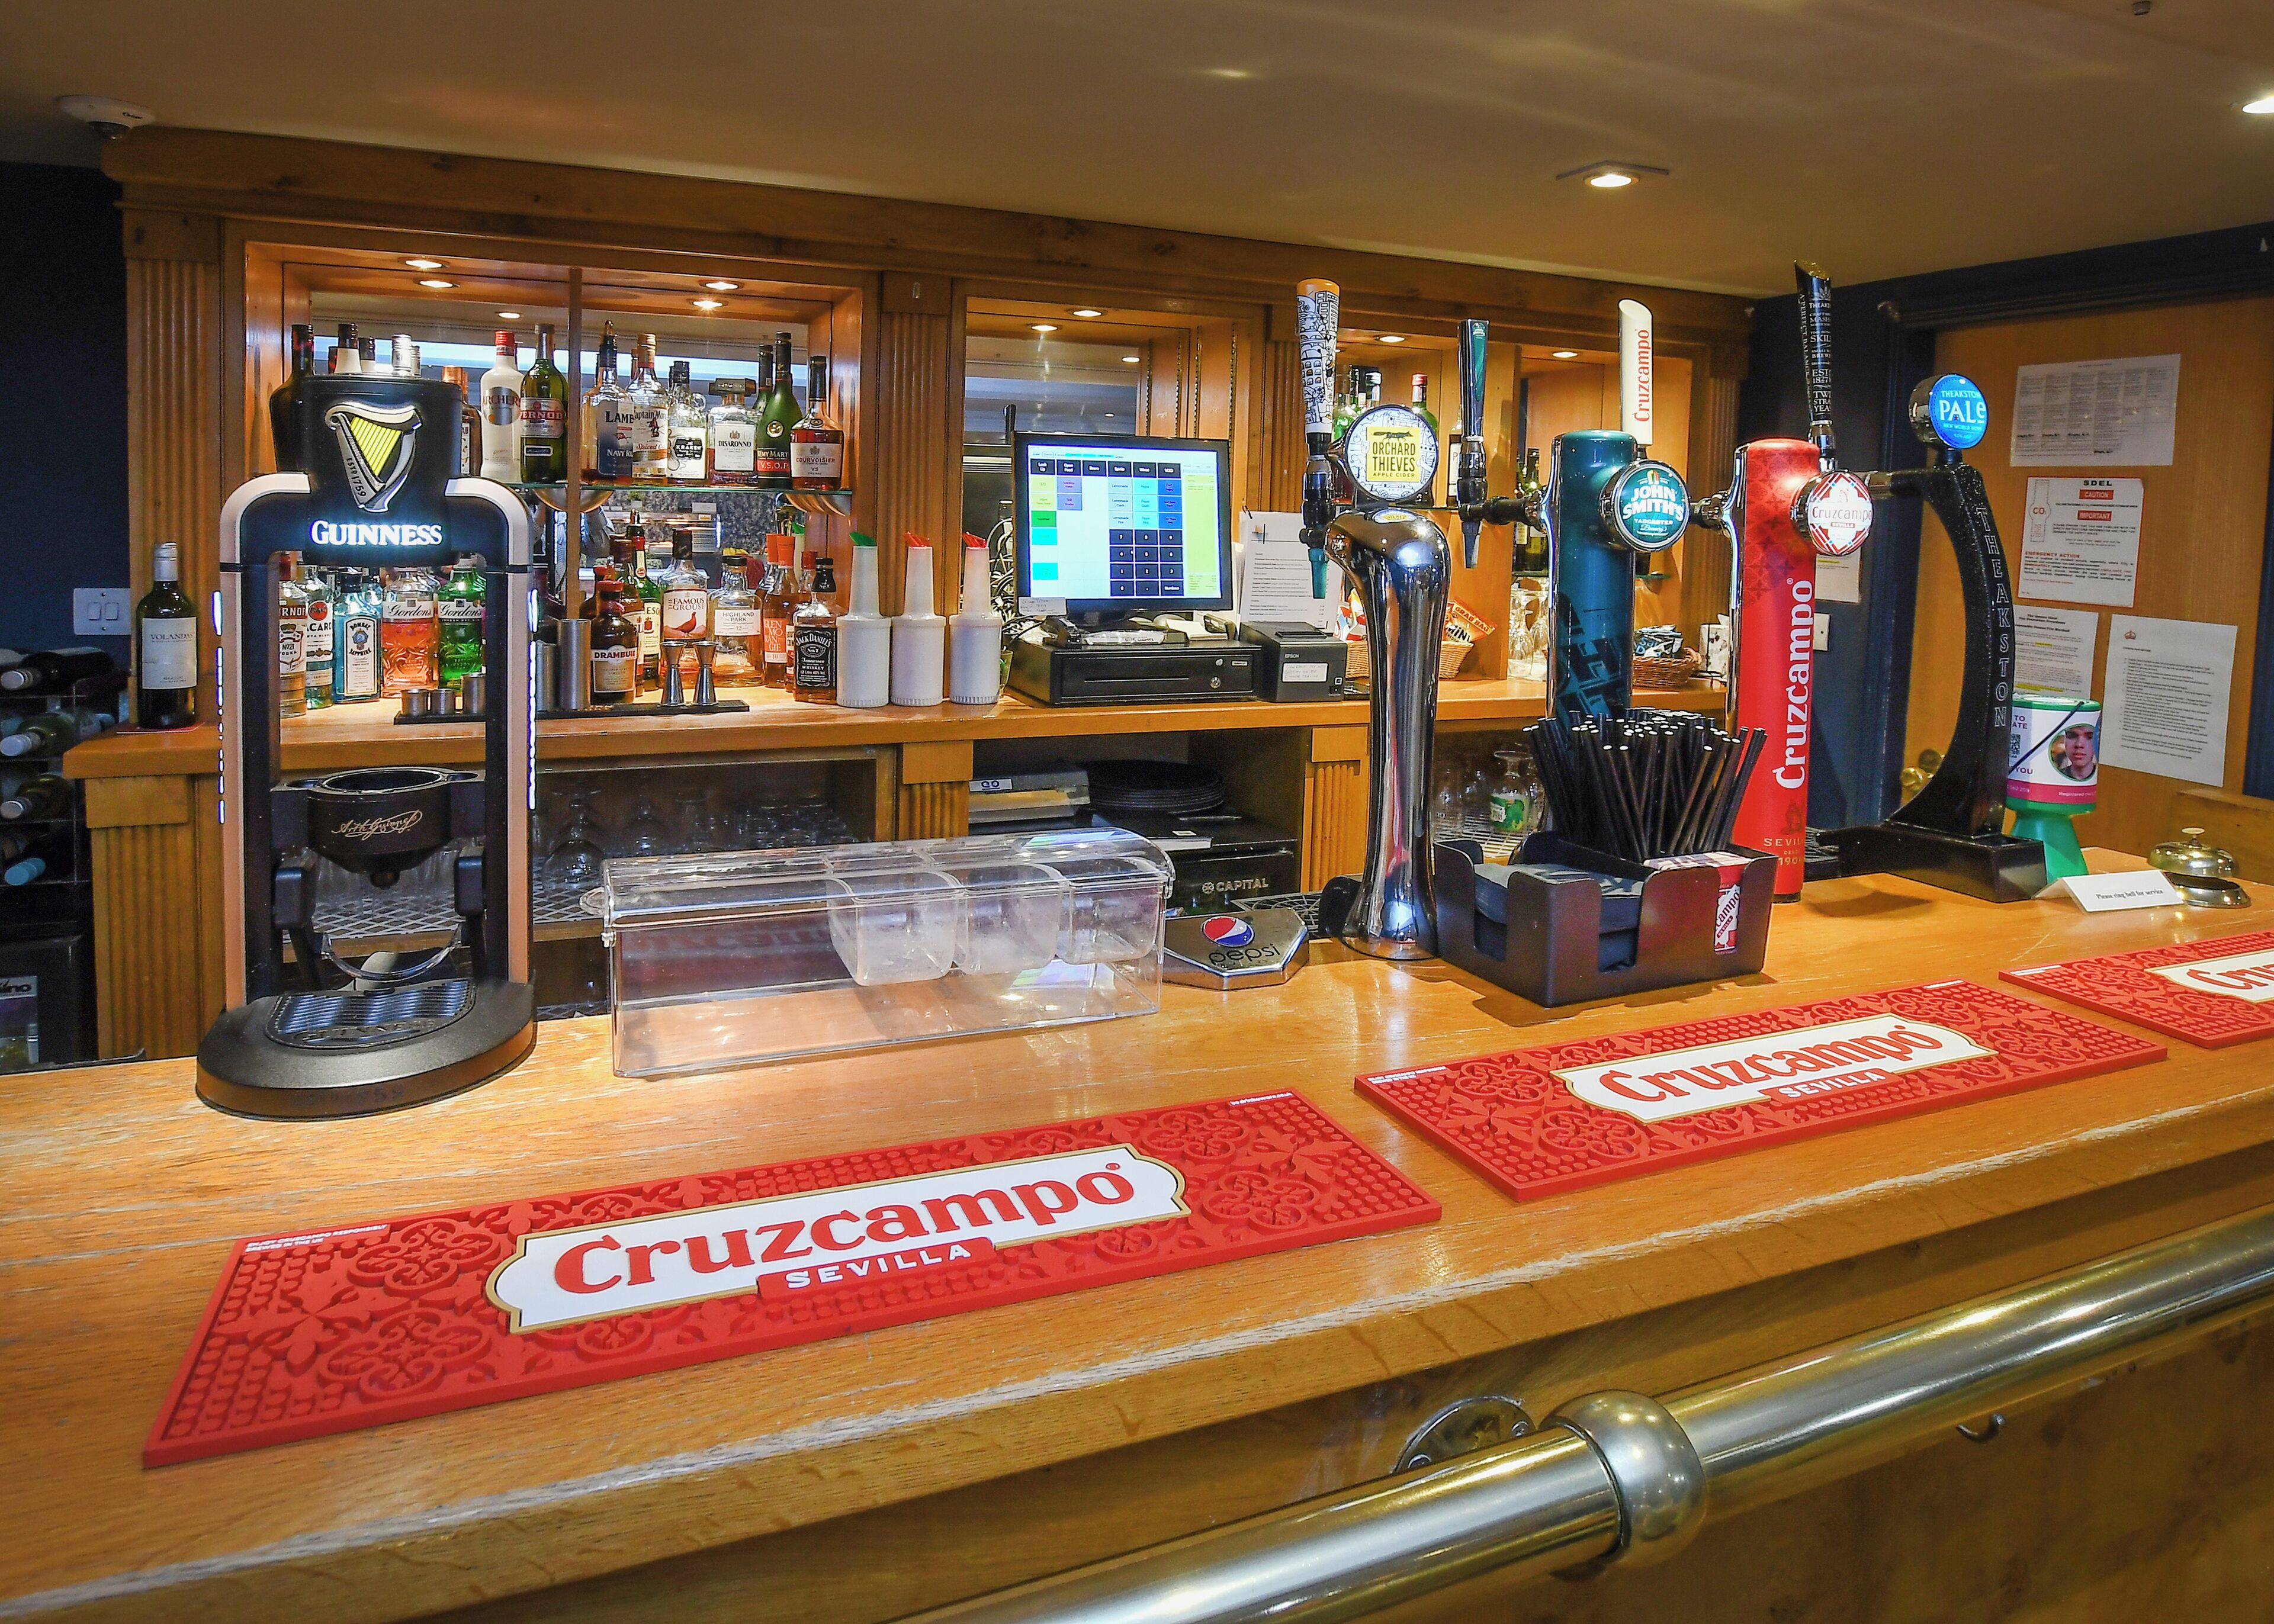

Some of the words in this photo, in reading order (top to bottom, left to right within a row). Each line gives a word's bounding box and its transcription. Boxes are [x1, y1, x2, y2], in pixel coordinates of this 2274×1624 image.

[1810, 335, 1831, 343] SKIL
[1633, 329, 1650, 422] Cruzcampo
[521, 411, 563, 420] PERNOD
[634, 409, 654, 420] aptain
[607, 449, 625, 457] NAVY
[1372, 442, 1415, 455] ORCHARD
[1372, 457, 1415, 472] THIEVES
[351, 475, 367, 497] 1759
[1631, 485, 1676, 502] JOHN
[1623, 499, 1684, 522] SMITH'S
[311, 520, 443, 546] GUINNESS
[1455, 606, 1475, 622] GRAB
[1976, 507, 2010, 727] THEAKSTON
[349, 622, 371, 631] BOMBAY
[769, 628, 783, 636] MO
[795, 634, 810, 647] JACK
[810, 633, 833, 648] DANIEL'S
[349, 647, 372, 656] SAPPHIRE
[1772, 580, 1813, 789] Cruzcampo
[1778, 857, 1801, 866] 190
[1216, 878, 1268, 892] CAPITAL
[1209, 943, 1280, 966] pepsi
[1599, 1028, 1942, 1102] Cruzcampo
[1777, 1070, 1886, 1099] SEVILLA
[247, 1239, 277, 1247] ENJOY
[332, 1224, 387, 1236] RESPONSIBLY
[553, 1171, 1135, 1295] Cruzcampo
[786, 1244, 972, 1289] SEVILLA
